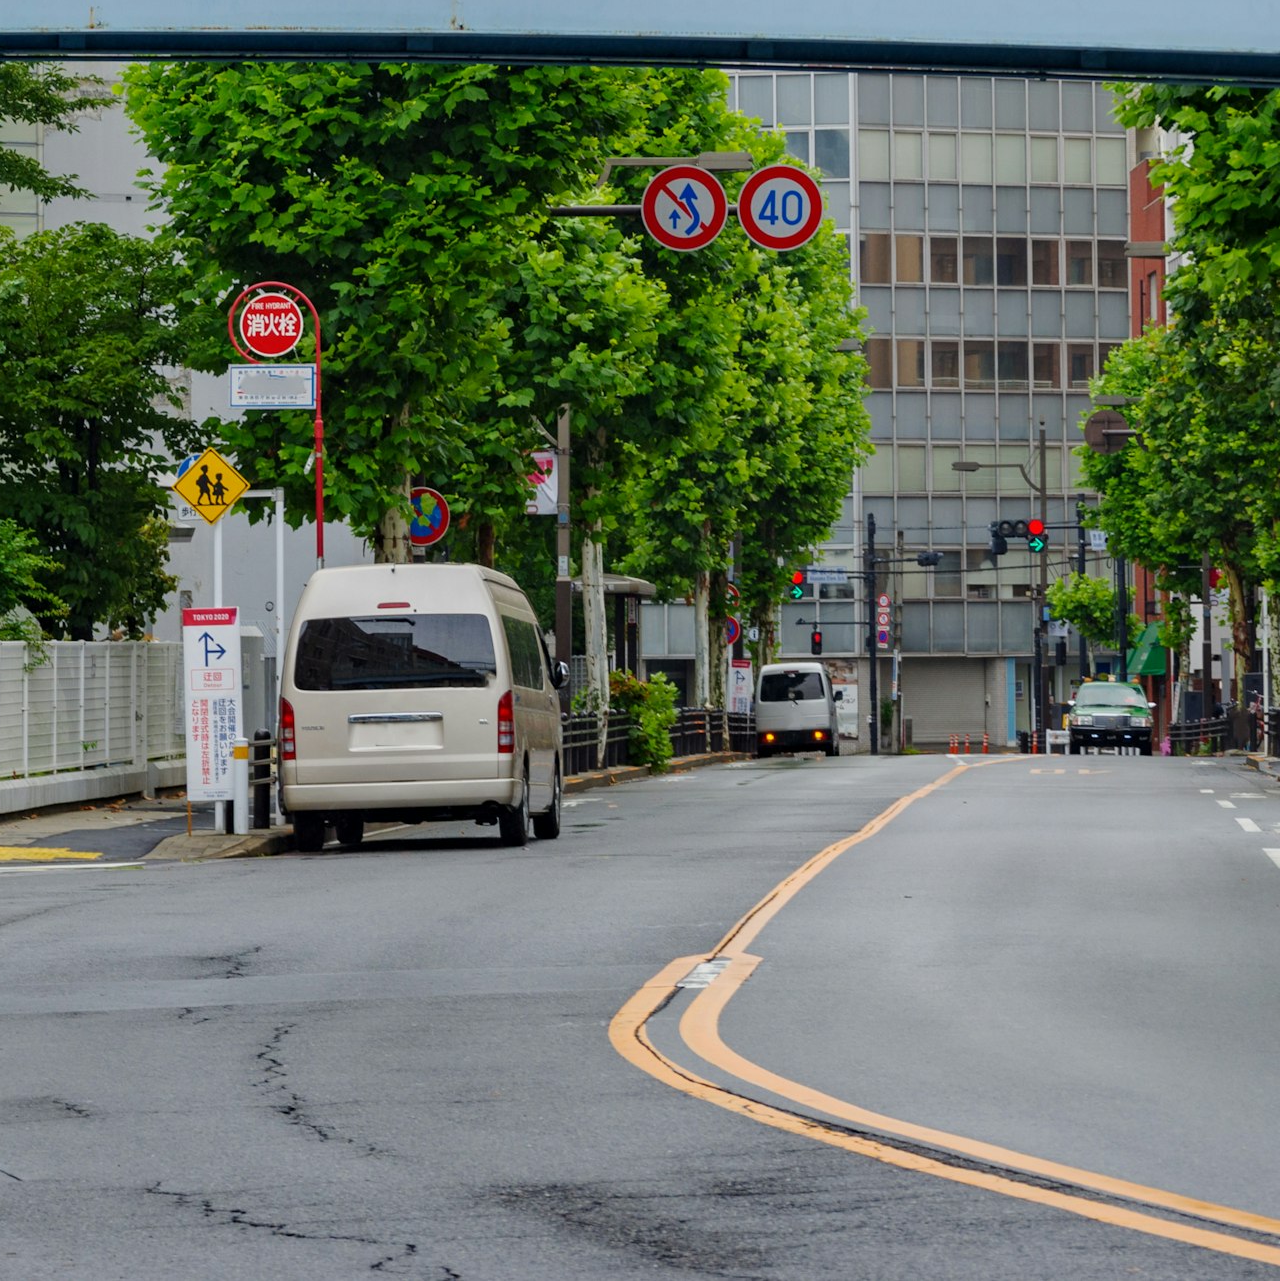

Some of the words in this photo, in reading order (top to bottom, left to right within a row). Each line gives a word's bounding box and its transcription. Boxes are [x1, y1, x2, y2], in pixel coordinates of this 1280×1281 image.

[758, 189, 803, 226] 40
[251, 302, 264, 310] FIRE
[265, 302, 291, 310] HYDRANT
[247, 312, 297, 337] 消火栓
[193, 613, 213, 622] TOKYO
[213, 613, 230, 621] 2020
[203, 672, 223, 682] 迂回
[191, 699, 200, 742] となります
